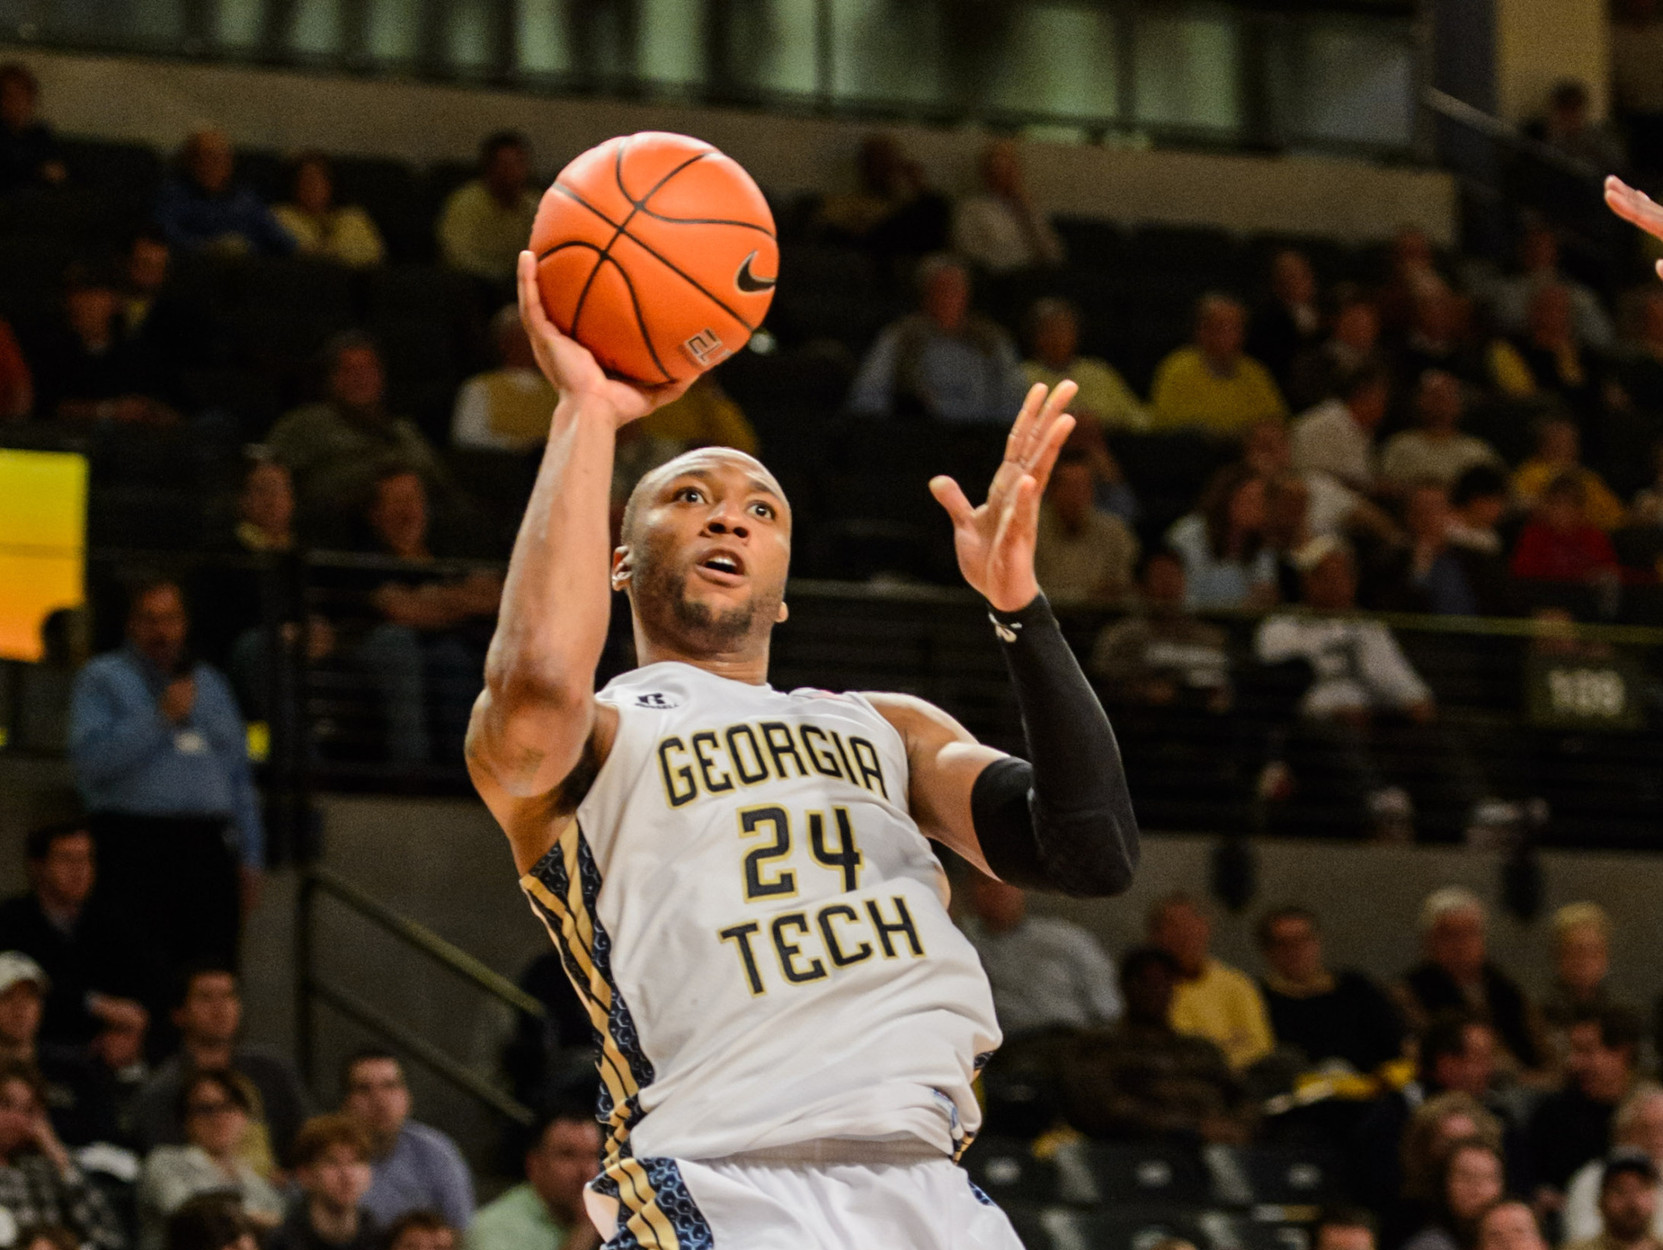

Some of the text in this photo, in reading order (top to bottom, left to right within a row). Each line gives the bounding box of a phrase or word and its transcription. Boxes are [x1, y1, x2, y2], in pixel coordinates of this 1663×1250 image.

[657, 721, 890, 810] GEORGIA
[737, 802, 864, 904] 24
[717, 894, 927, 998] TECH
